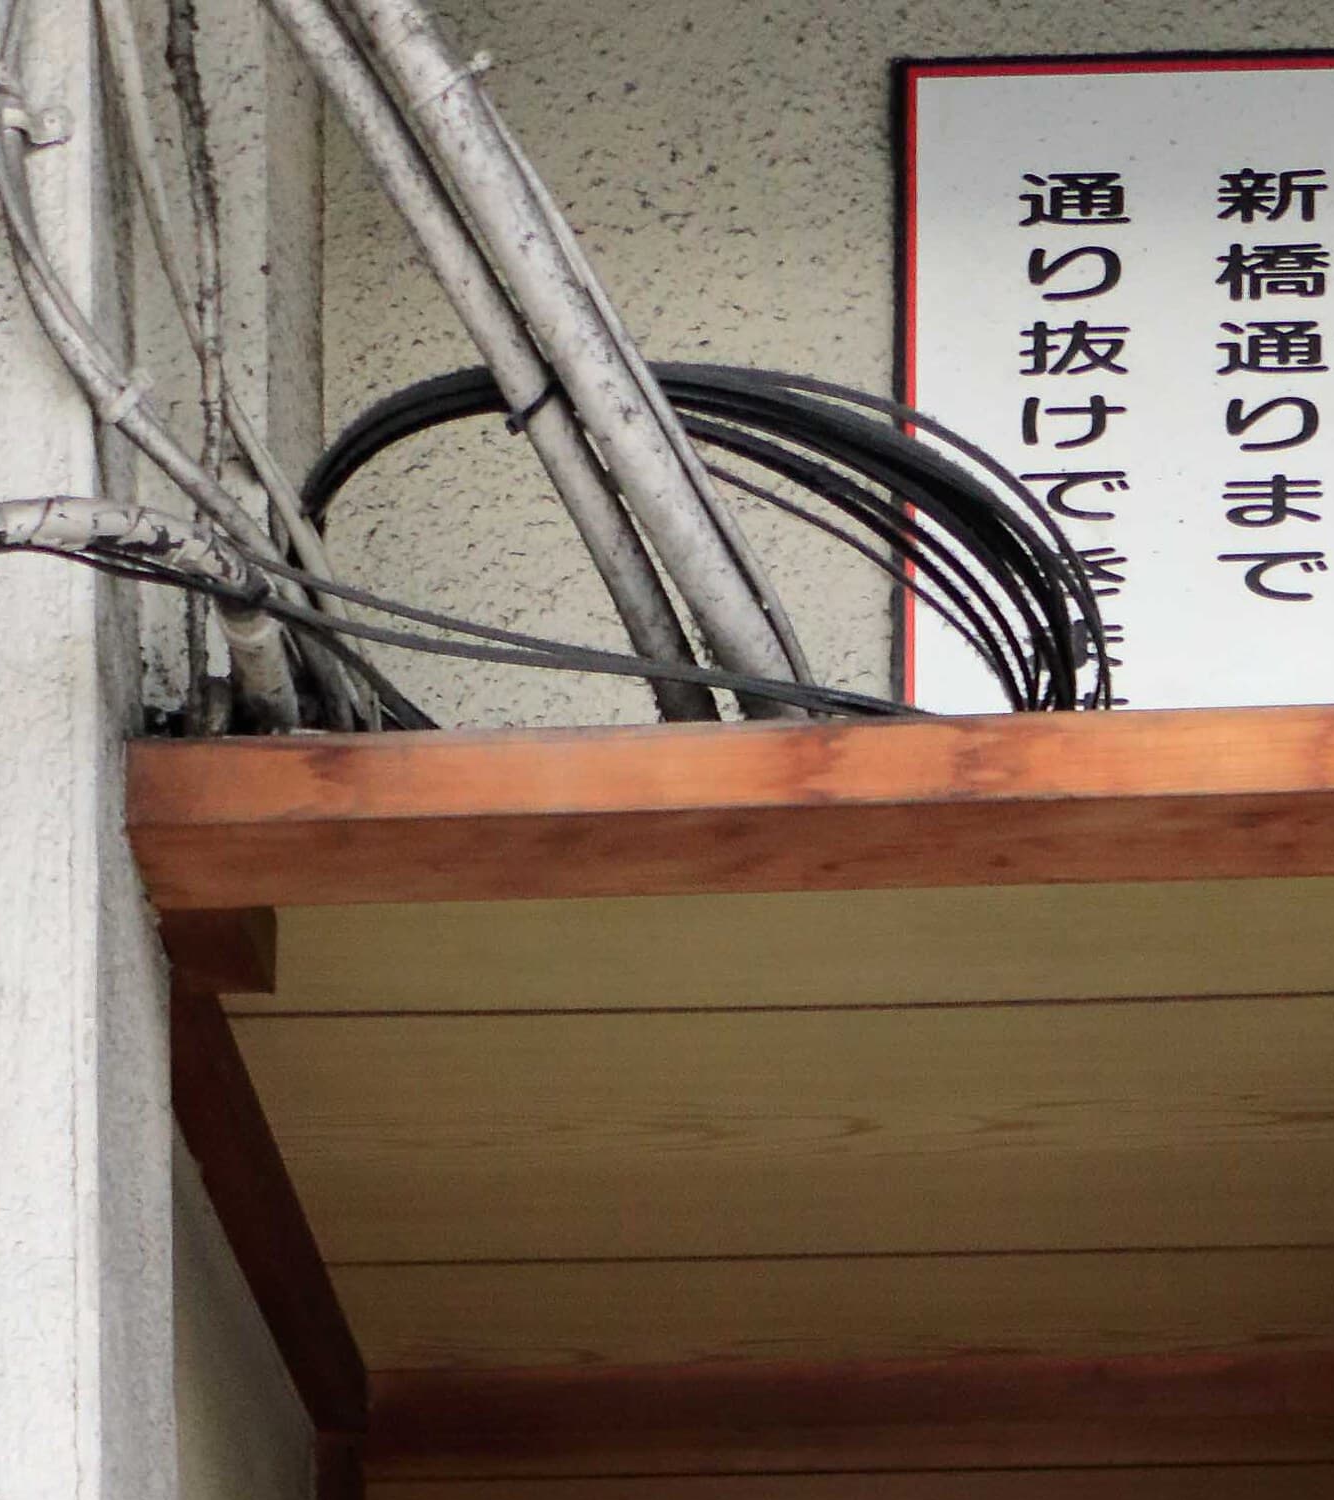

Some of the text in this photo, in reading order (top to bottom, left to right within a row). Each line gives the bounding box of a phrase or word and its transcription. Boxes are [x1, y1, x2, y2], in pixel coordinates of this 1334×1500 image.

[1215, 166, 1331, 602] 新橋通りまで
